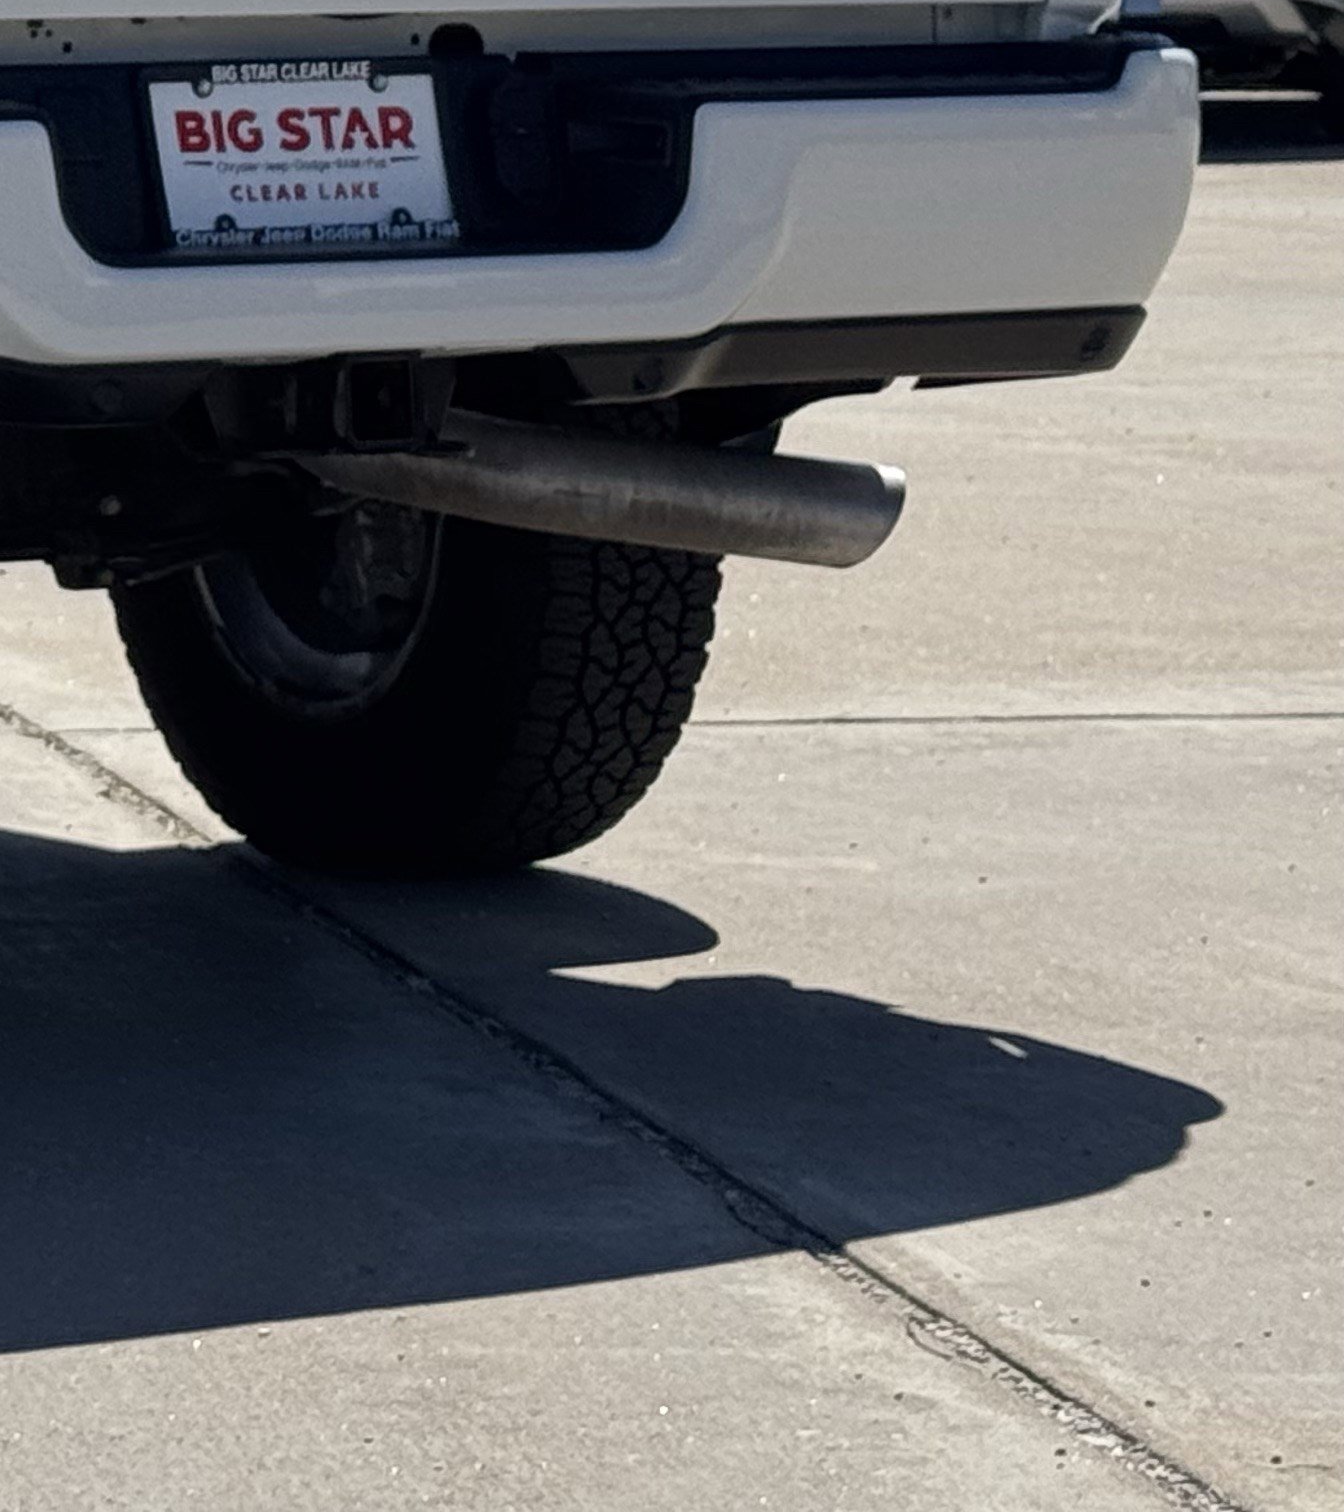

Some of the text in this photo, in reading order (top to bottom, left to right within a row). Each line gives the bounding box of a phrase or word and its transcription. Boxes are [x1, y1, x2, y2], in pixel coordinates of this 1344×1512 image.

[212, 60, 371, 82] BIG STAR CLEAR LAKE
[174, 106, 416, 153] BIG STAR
[230, 182, 380, 202] CLEAR LAKE
